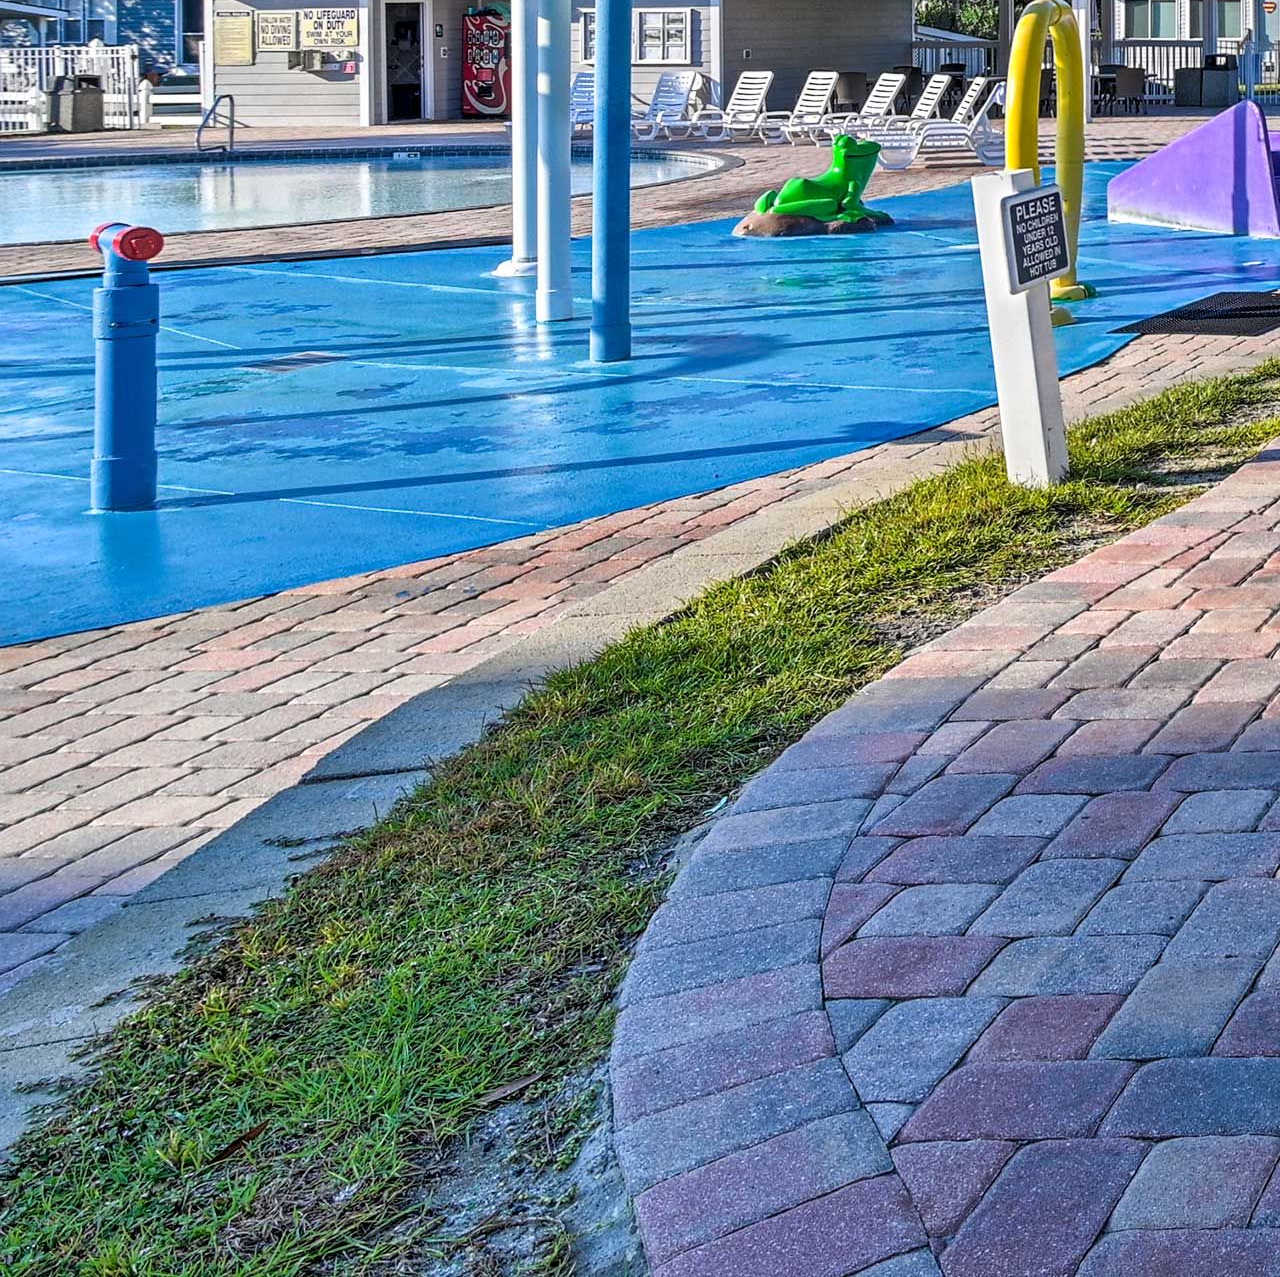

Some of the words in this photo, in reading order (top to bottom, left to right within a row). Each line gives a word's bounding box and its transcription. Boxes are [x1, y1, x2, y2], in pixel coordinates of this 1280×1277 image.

[303, 10, 313, 19] NO
[317, 9, 355, 19] LIFEGUARD
[260, 25, 269, 34] NO
[271, 25, 292, 34] DIVING
[314, 21, 323, 30] ON
[327, 21, 345, 30] DUTY
[261, 35, 291, 45] ALLOWED
[1016, 197, 1056, 221] PLEASE
[1016, 223, 1026, 234] NO
[1027, 212, 1059, 231] CHILDREN
[1024, 229, 1046, 243] UNDER
[1047, 226, 1054, 236] 12
[1023, 240, 1045, 256] YEARS
[1045, 236, 1058, 248] OLD
[1023, 249, 1053, 268] ALLOWED
[1055, 246, 1061, 256] IN
[1029, 264, 1043, 277] HOT
[1044, 259, 1057, 271] TUB
